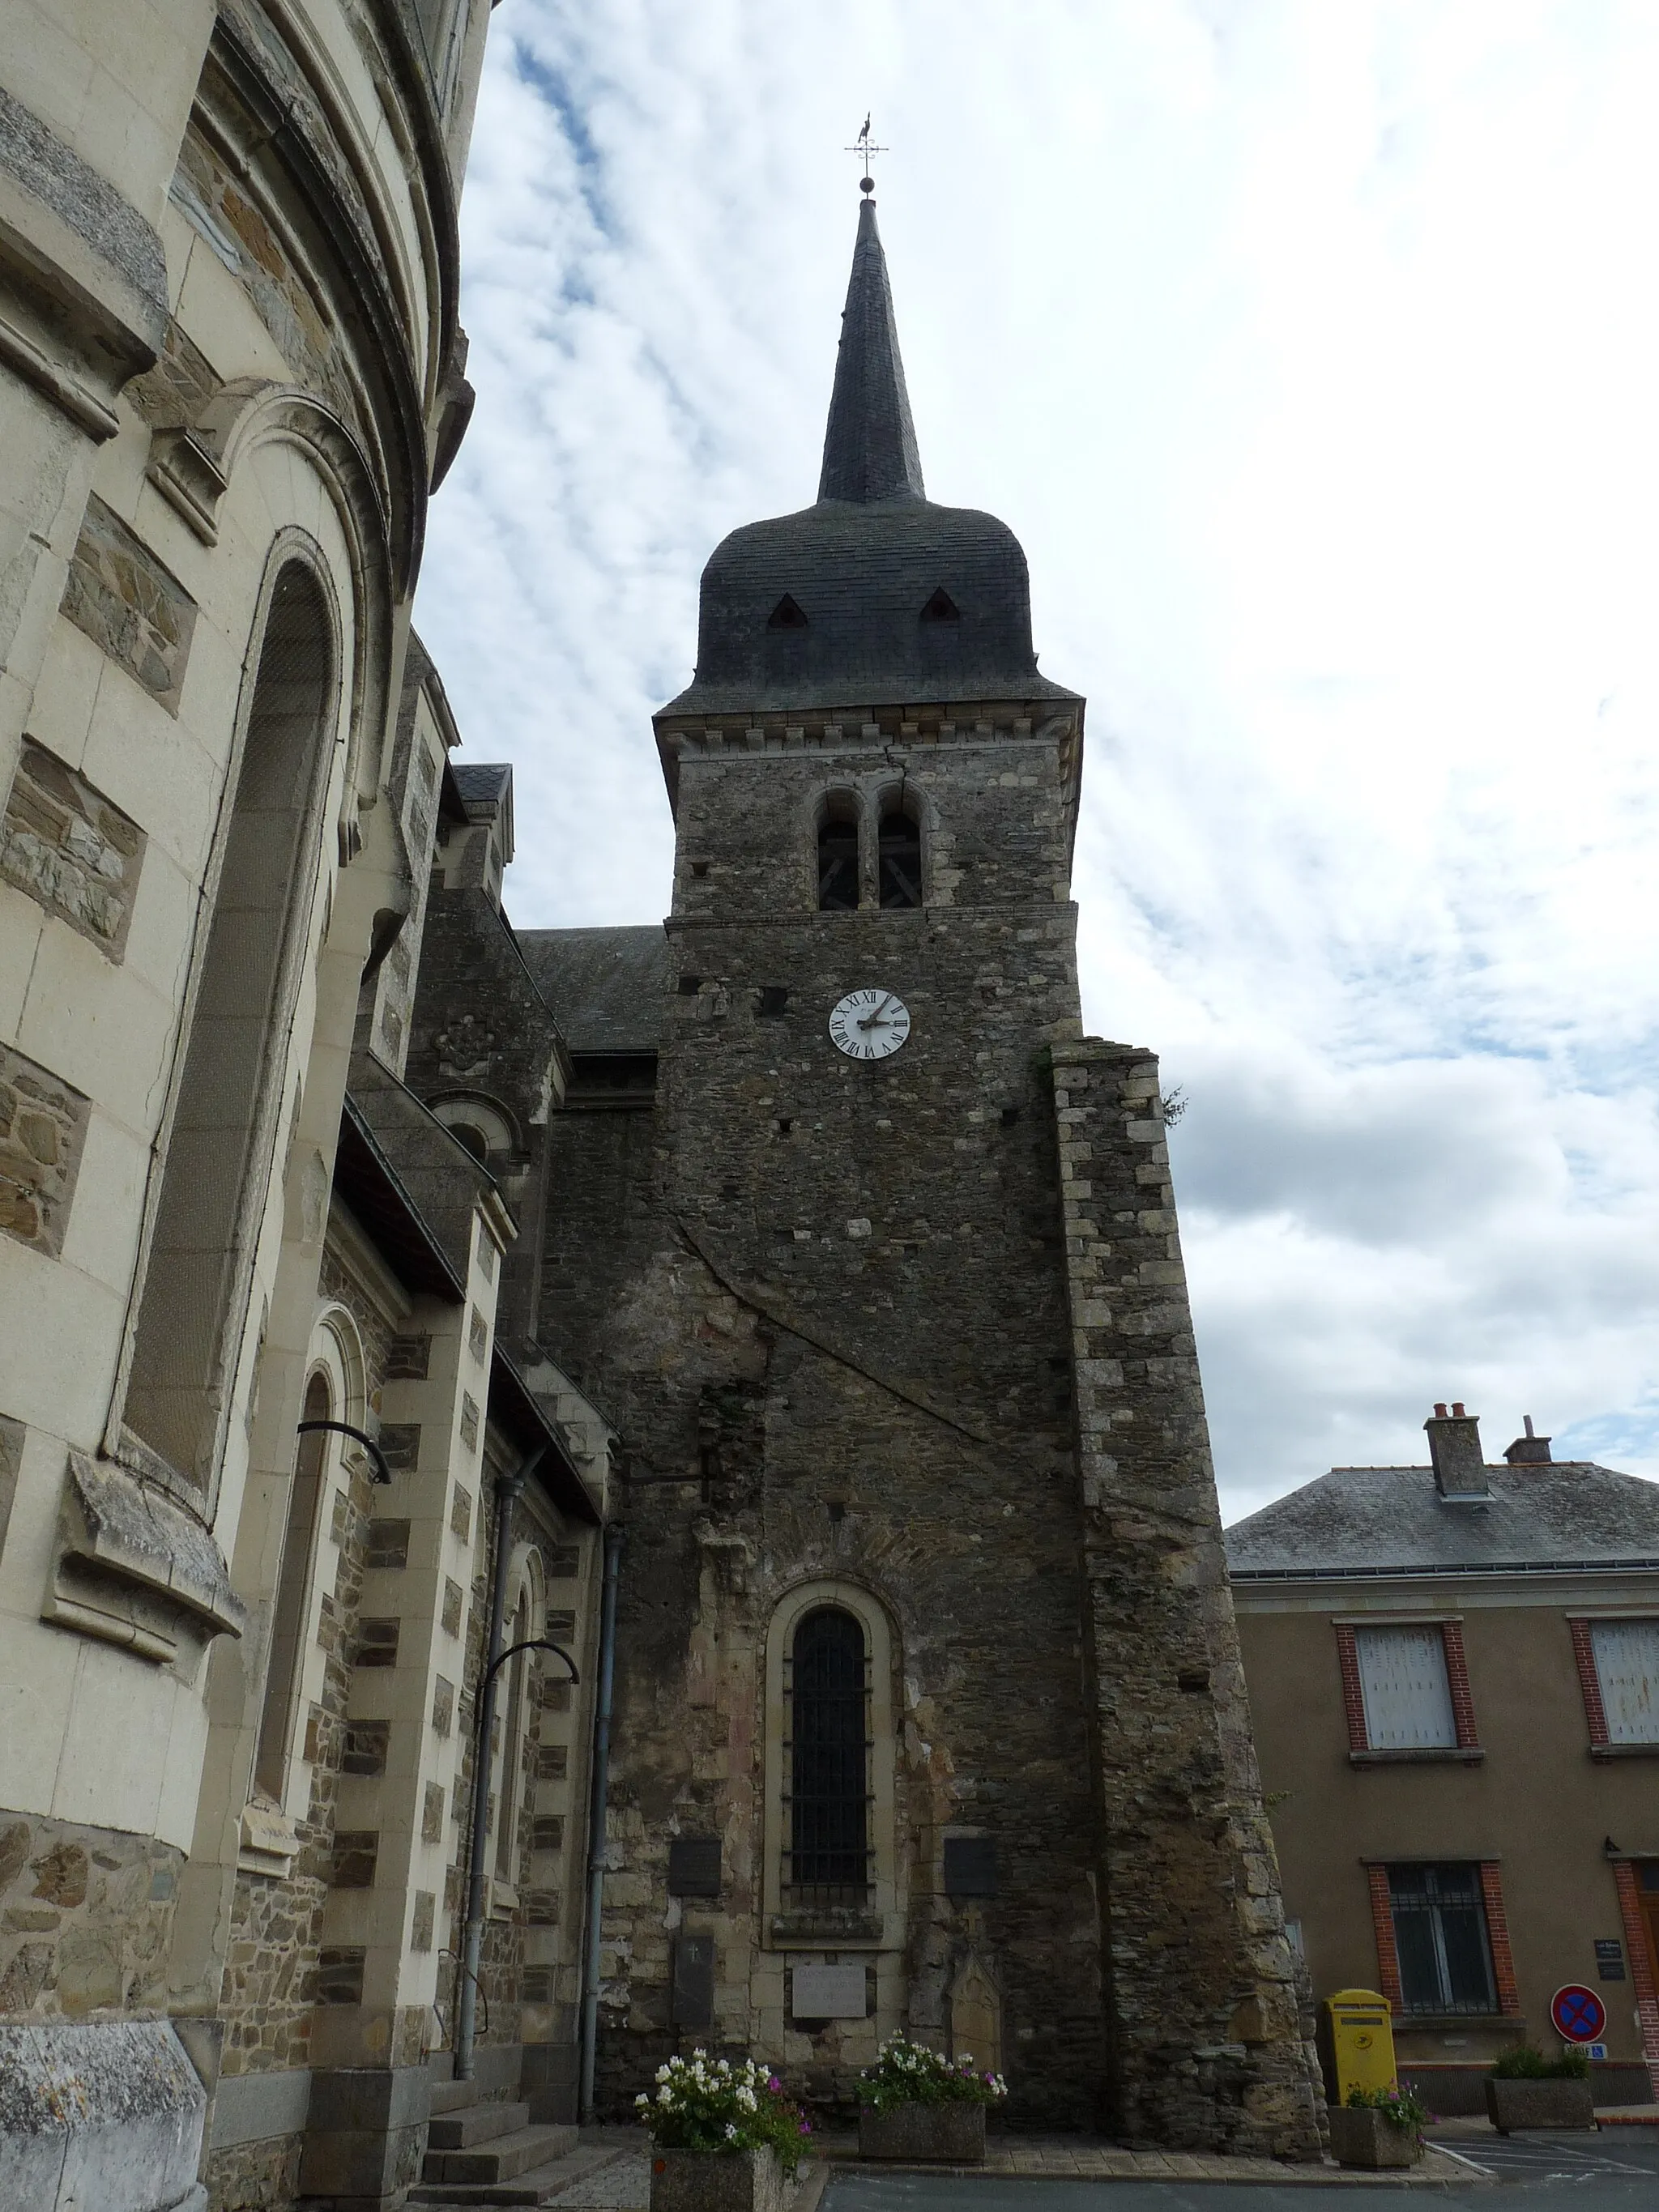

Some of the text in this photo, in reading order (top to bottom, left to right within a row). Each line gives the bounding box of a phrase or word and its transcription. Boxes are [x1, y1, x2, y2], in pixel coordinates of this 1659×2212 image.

[846, 995, 860, 1009] XI
[863, 991, 876, 1004] XII
[836, 1006, 850, 1017] X
[890, 1005, 903, 1015] II
[831, 1020, 844, 1029] IX
[834, 1031, 849, 1047] VIII
[890, 1033, 904, 1045] IV
[847, 1042, 860, 1056] VII
[864, 1046, 876, 1058] VI
[882, 1042, 892, 1054] V
